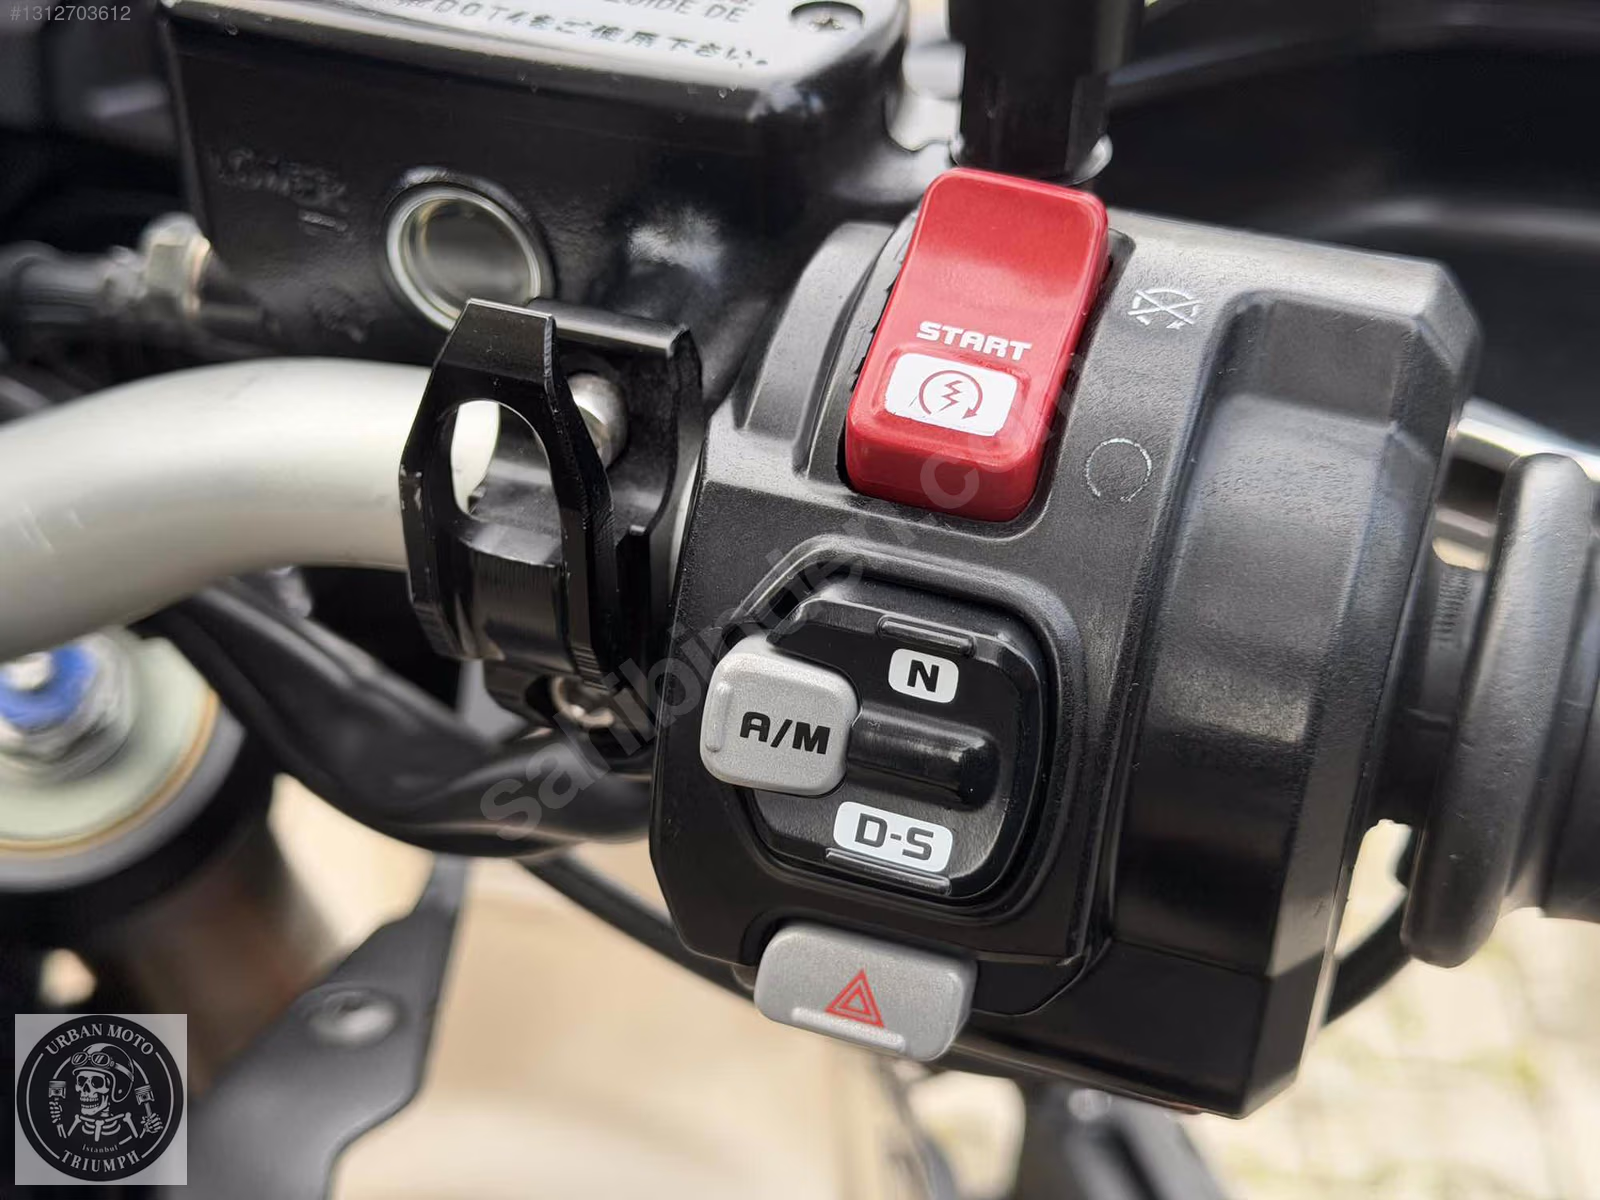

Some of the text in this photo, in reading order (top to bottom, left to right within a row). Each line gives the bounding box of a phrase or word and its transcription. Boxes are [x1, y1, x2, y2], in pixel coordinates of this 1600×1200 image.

[916, 321, 1032, 361] START
[906, 659, 940, 693] N
[739, 711, 831, 755] A/M
[854, 812, 935, 861] D-S
